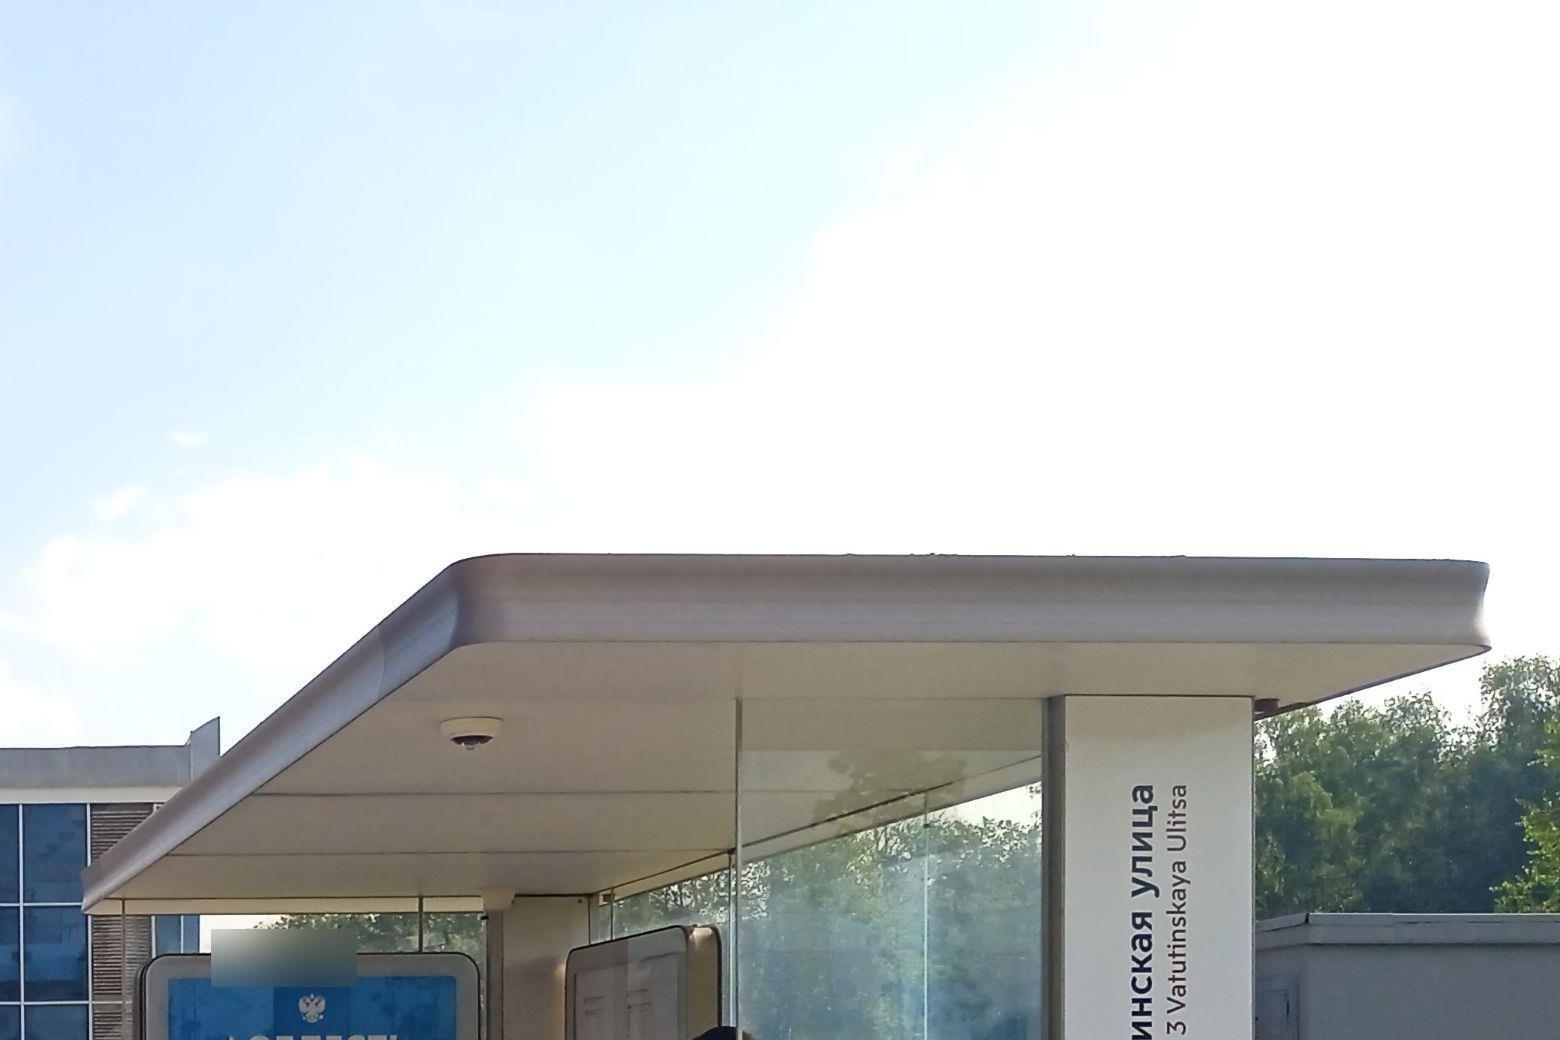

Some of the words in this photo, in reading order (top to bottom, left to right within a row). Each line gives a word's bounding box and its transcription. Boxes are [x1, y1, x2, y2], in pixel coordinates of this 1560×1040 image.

[1131, 783, 1160, 898] улица
[1165, 783, 1187, 852] Ulitsa
[1165, 860, 1191, 1015] Vatutinskaya
[1166, 1020, 1186, 1035] 3
